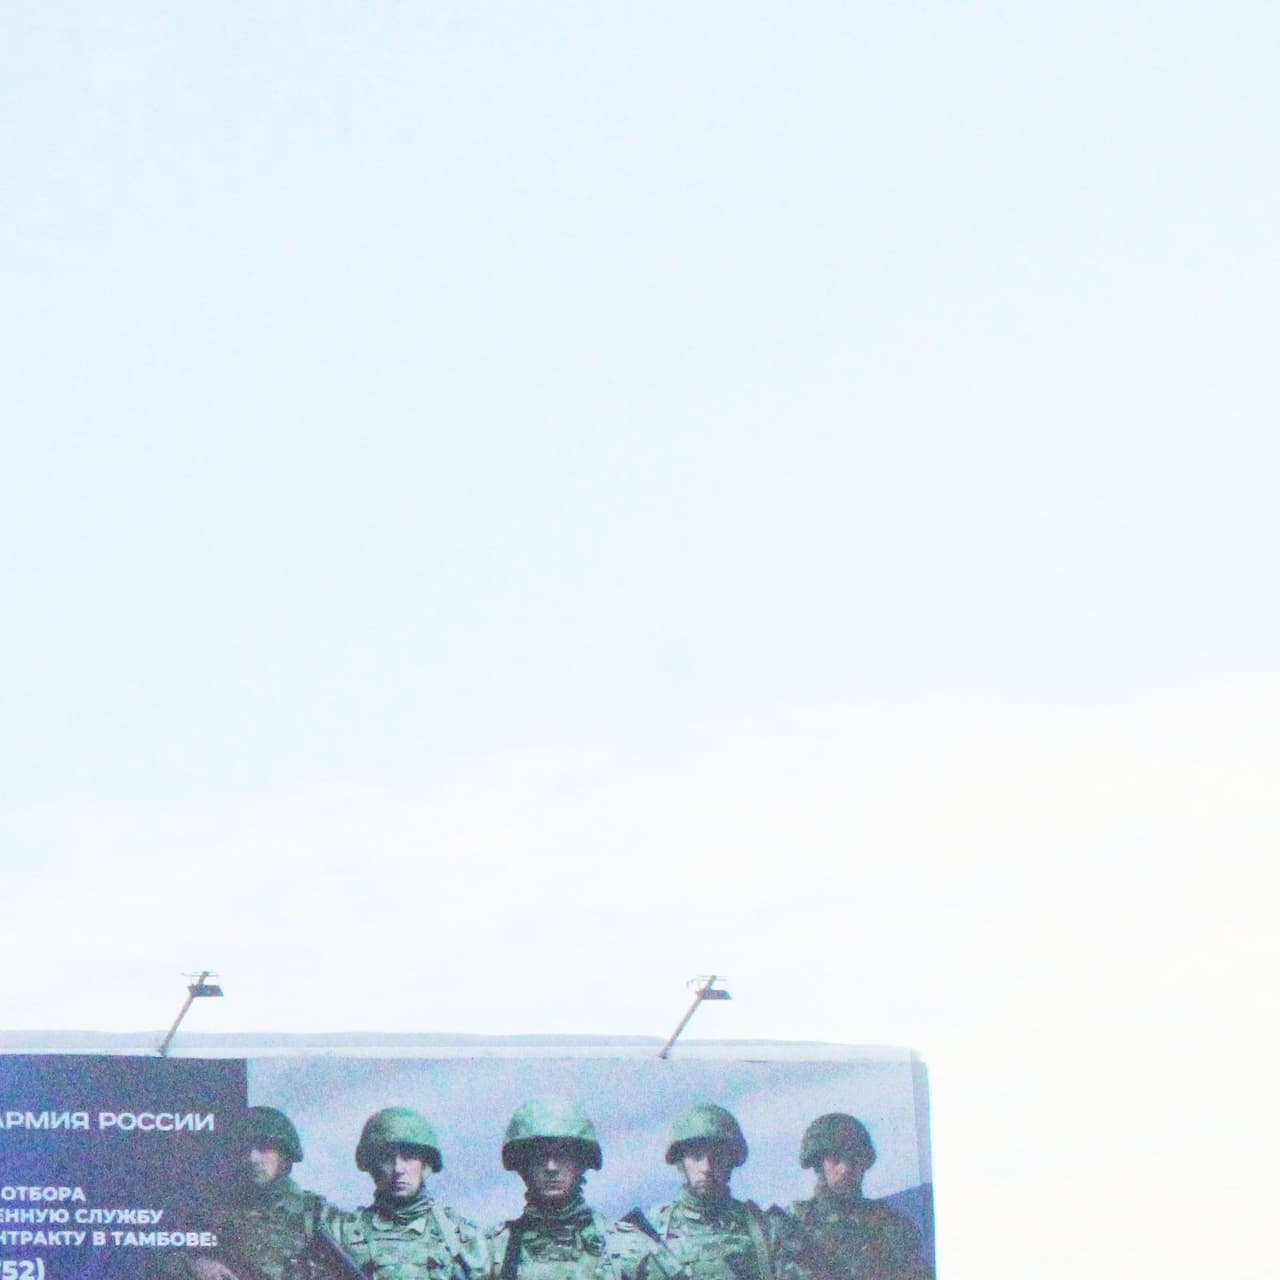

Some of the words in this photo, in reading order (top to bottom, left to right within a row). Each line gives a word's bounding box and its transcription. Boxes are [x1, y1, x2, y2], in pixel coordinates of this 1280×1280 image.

[98, 1112, 215, 1132] РОССИИ
[0, 1186, 86, 1202] ОТБОРА
[74, 1209, 163, 1225] СЛУЖБУ
[92, 1232, 106, 1246] В
[111, 1232, 219, 1247] ТАМБОВЕ:
